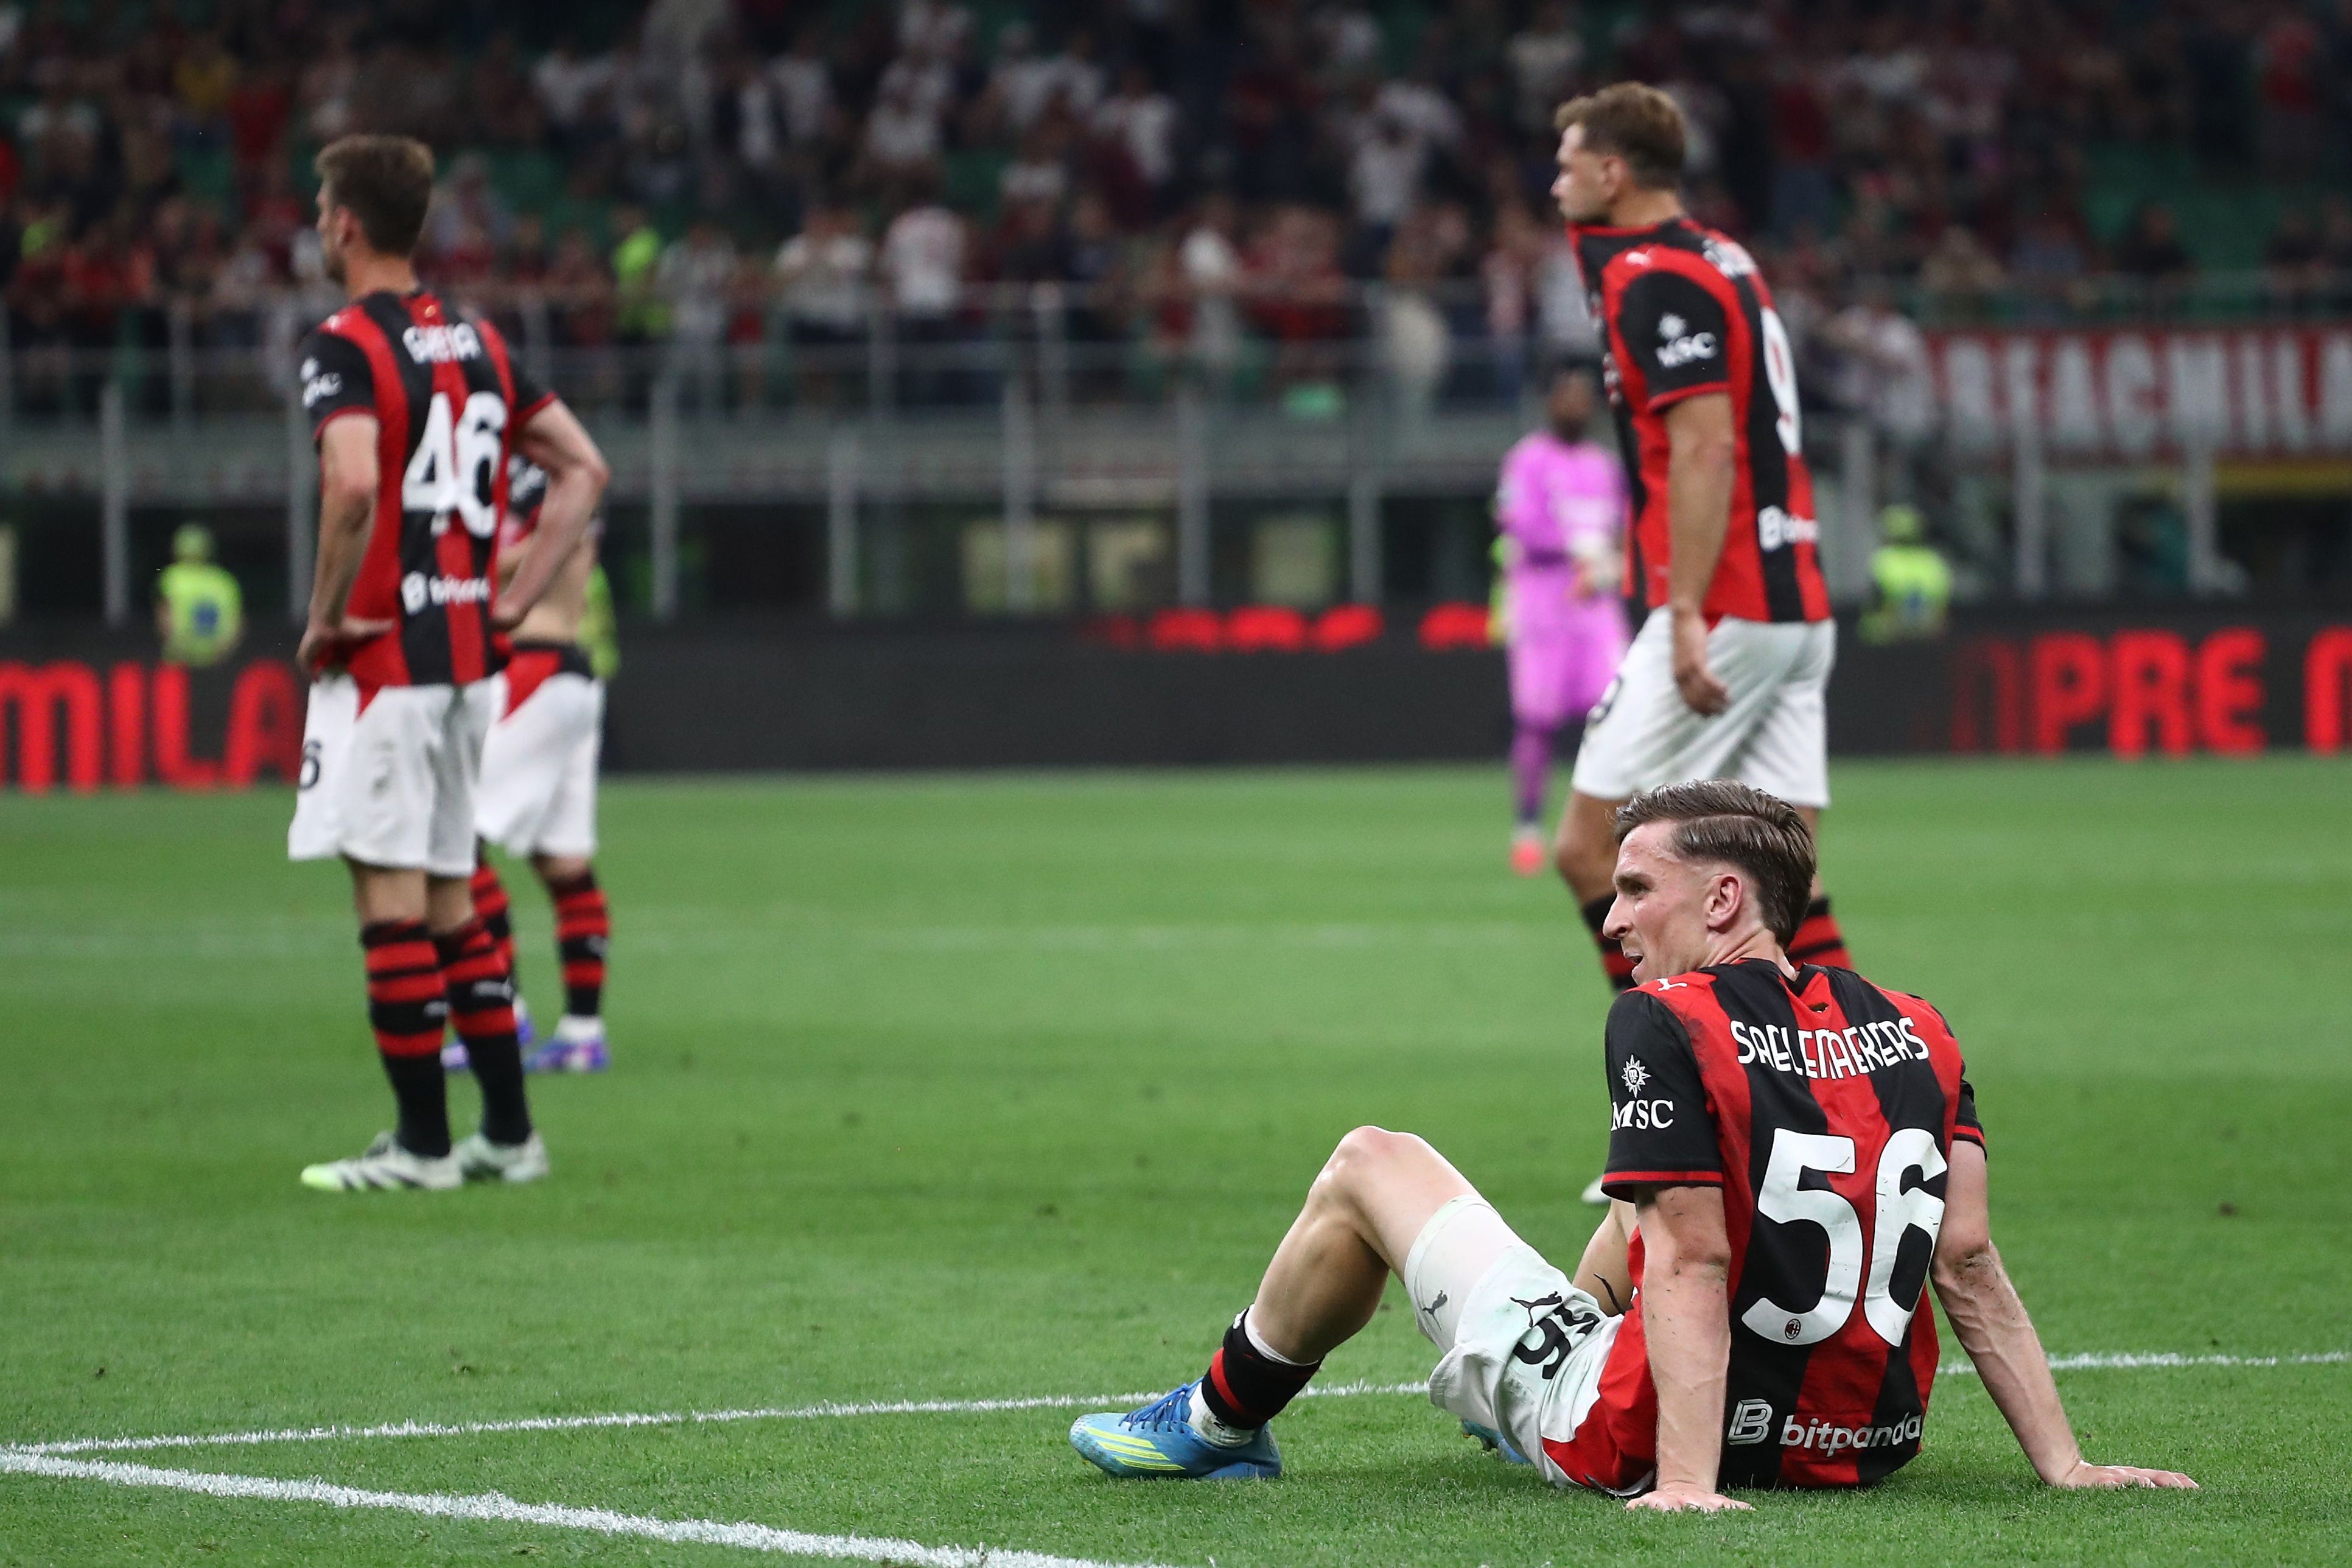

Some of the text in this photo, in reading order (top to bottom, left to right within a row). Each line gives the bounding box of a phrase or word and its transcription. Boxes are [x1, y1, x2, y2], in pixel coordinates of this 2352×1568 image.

[401, 391, 508, 538] 46
[1730, 1017, 1930, 1079] SAELEMAEKERS
[1611, 1099, 1674, 1131] MSC
[1741, 1127, 1948, 1348] 56
[1779, 1412, 1922, 1457] bitpanda
